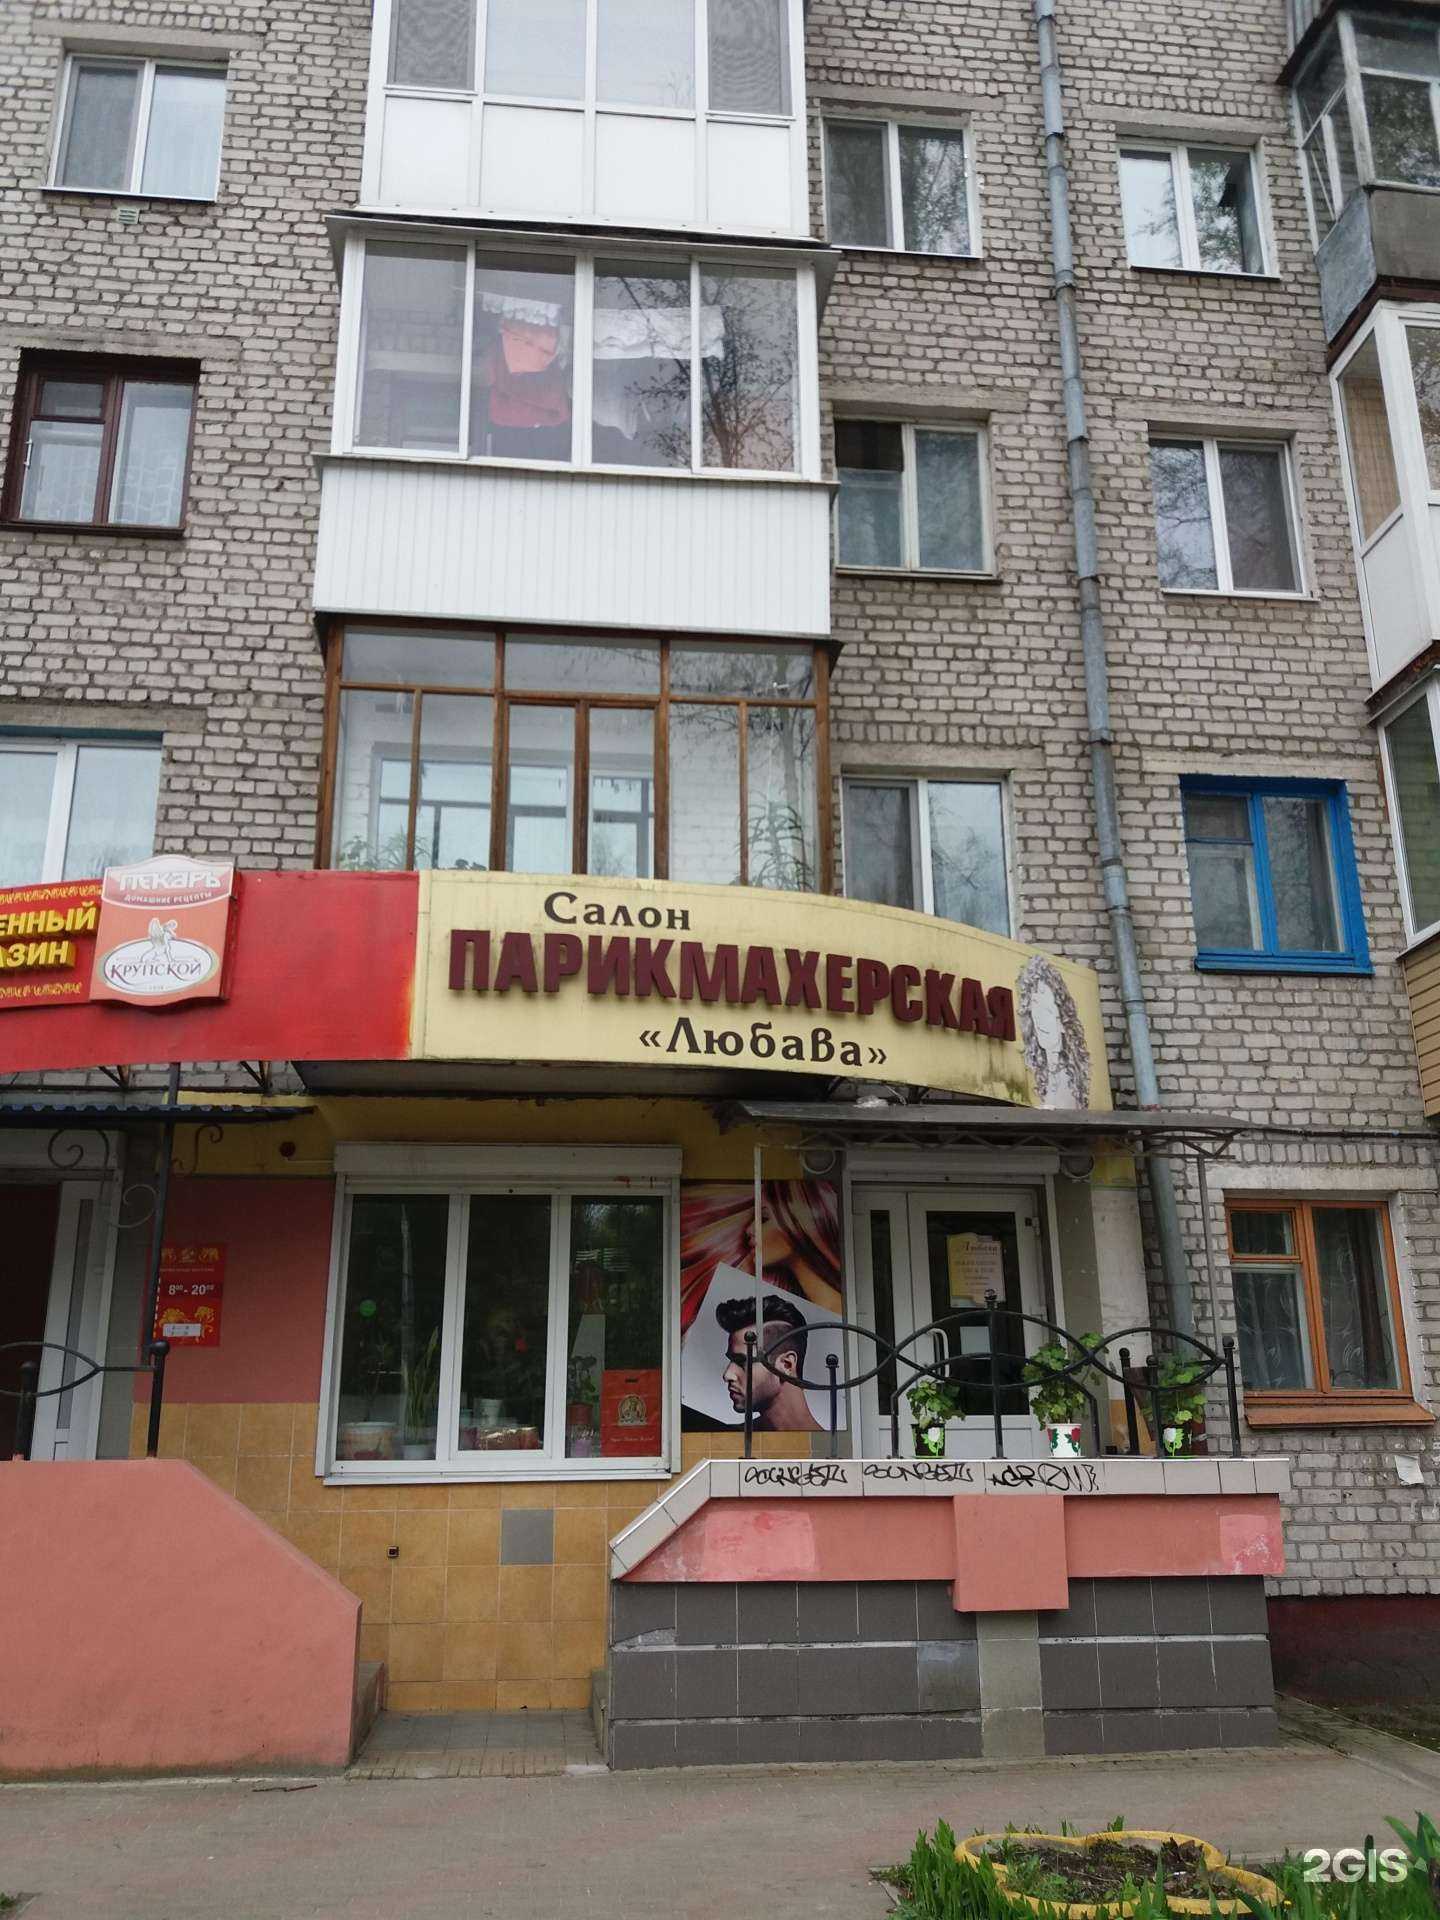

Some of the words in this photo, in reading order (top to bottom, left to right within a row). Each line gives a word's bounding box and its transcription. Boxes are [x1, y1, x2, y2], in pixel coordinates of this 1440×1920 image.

[544, 891, 691, 930] Салон
[110, 957, 201, 985] КРУПСКОЙ
[448, 929, 1016, 1042] ПАРИКМАХЕРСКАЯ
[638, 1016, 887, 1066] «Любава»
